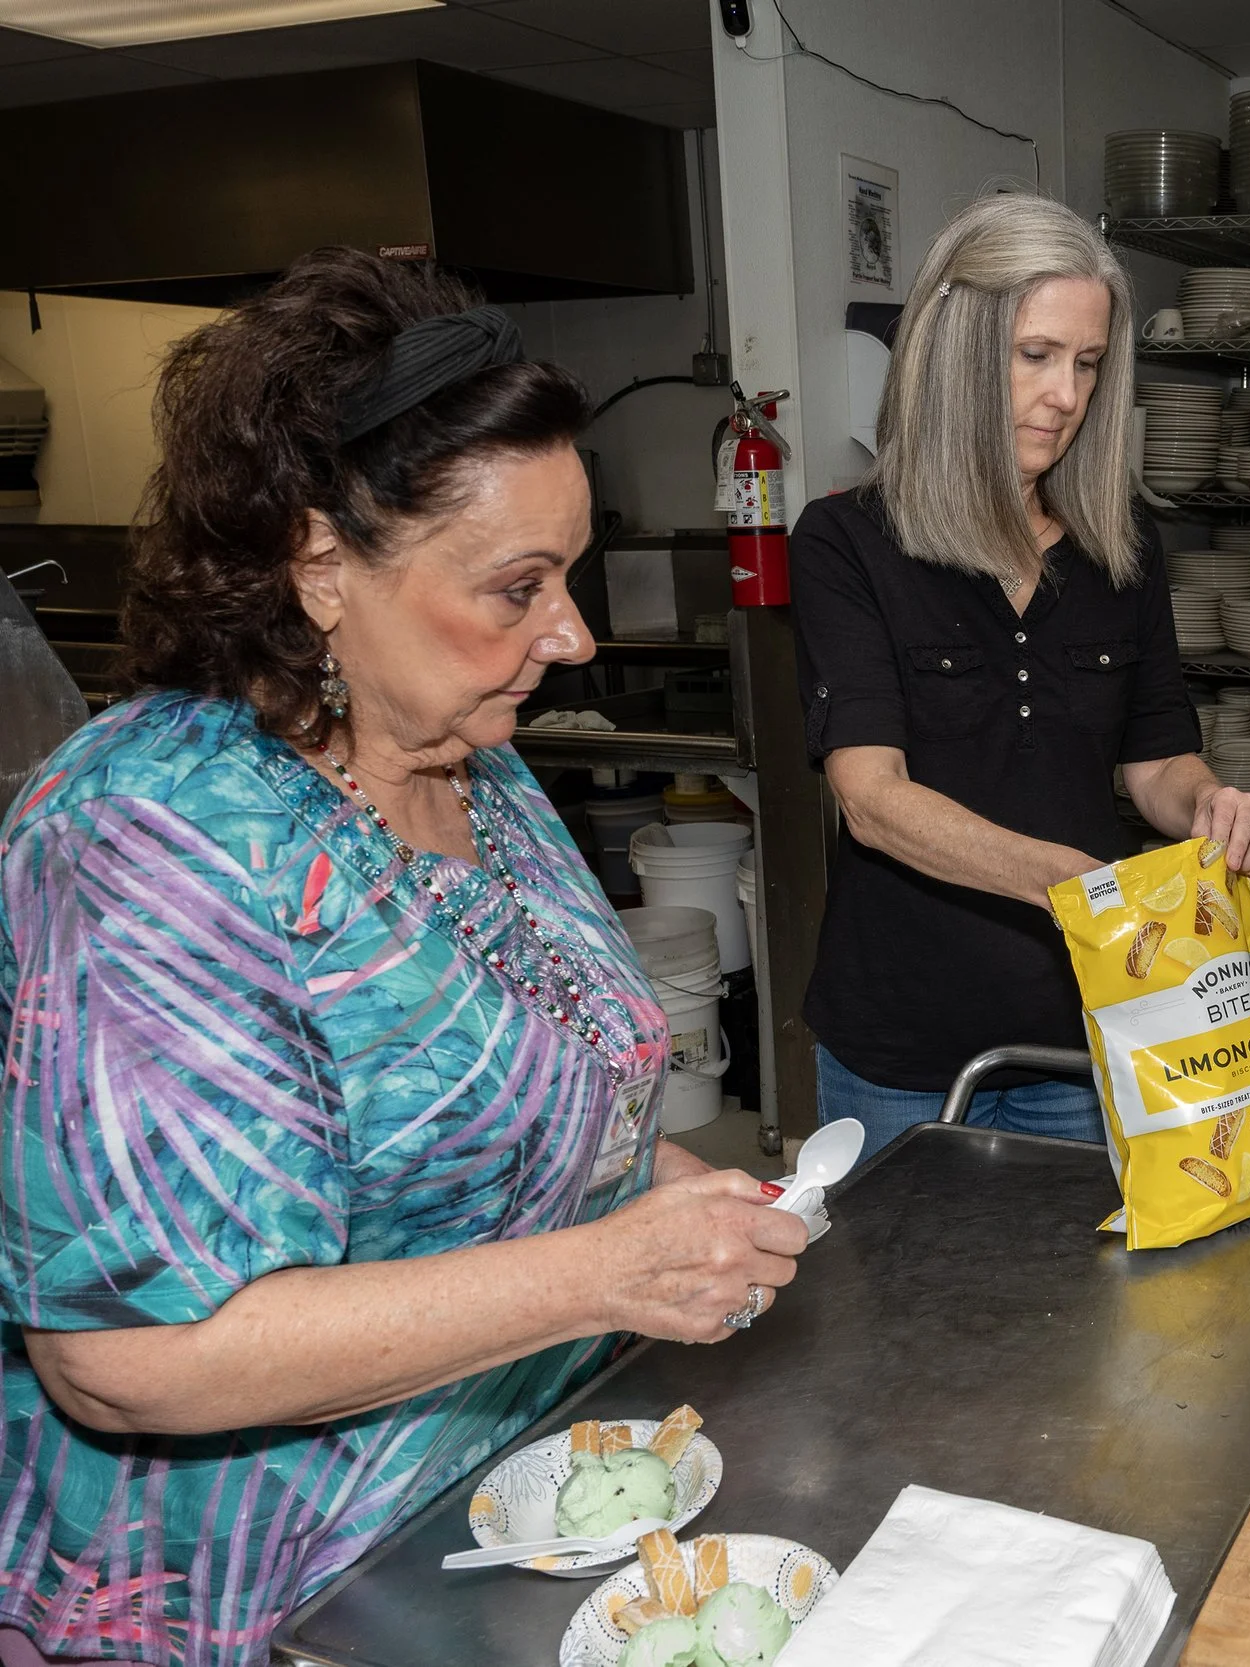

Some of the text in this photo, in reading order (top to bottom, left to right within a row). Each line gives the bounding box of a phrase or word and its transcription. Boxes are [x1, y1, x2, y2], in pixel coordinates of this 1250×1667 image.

[762, 476, 769, 520] A B C
[1088, 880, 1116, 894] LIMITED
[1090, 886, 1118, 900] EDITION
[1219, 980, 1245, 994] BAKERY
[1201, 1099, 1234, 1114] BITE-SIZED
